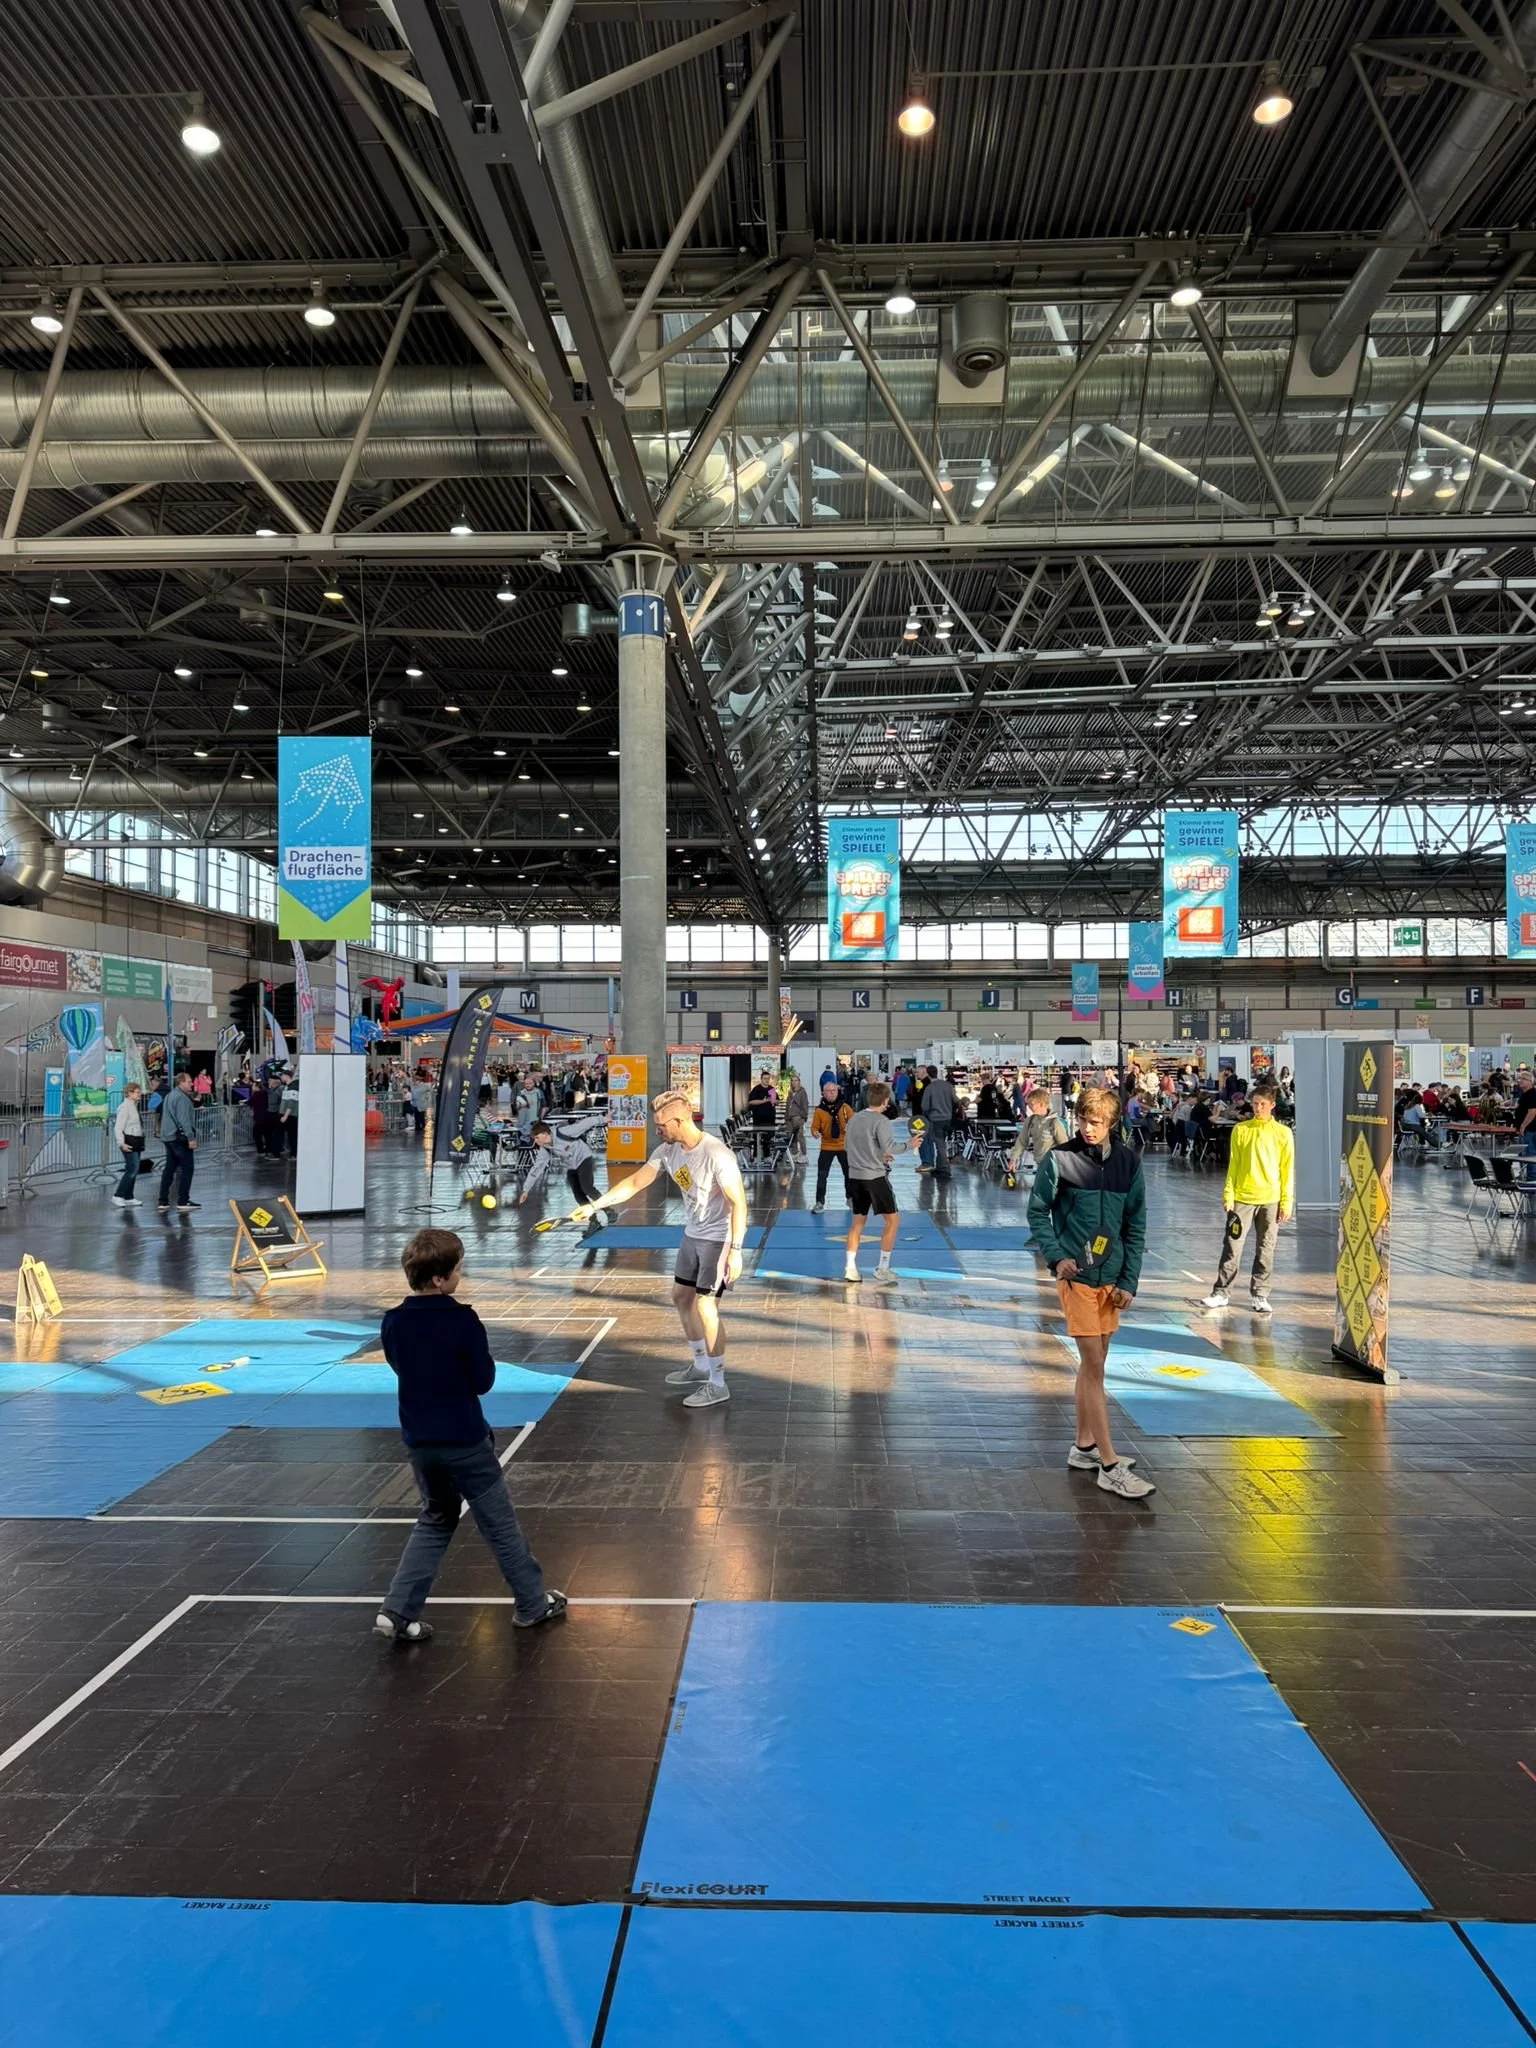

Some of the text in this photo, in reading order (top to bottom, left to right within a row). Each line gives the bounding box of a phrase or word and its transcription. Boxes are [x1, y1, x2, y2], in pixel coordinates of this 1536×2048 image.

[842, 833, 886, 843] gewinne
[1179, 826, 1224, 836] gewinne
[842, 844, 886, 853] SPIELE!
[1178, 837, 1224, 846] SPIELE!
[289, 850, 361, 862] Drachen-
[287, 863, 364, 879] flugfläche
[1171, 865, 1230, 878] SPIELER
[840, 882, 888, 897] PREIS
[1176, 876, 1226, 892] PREIS
[522, 993, 535, 1008] M
[685, 992, 693, 1007] L
[855, 992, 866, 1006] K
[988, 991, 994, 1006] J
[1169, 990, 1180, 1005] H
[1338, 989, 1351, 1004] G
[1470, 988, 1479, 1004] F
[466, 1020, 482, 1069] STREET
[458, 1080, 471, 1131] RACKET
[993, 1919, 1085, 1928] STREET RACKET
